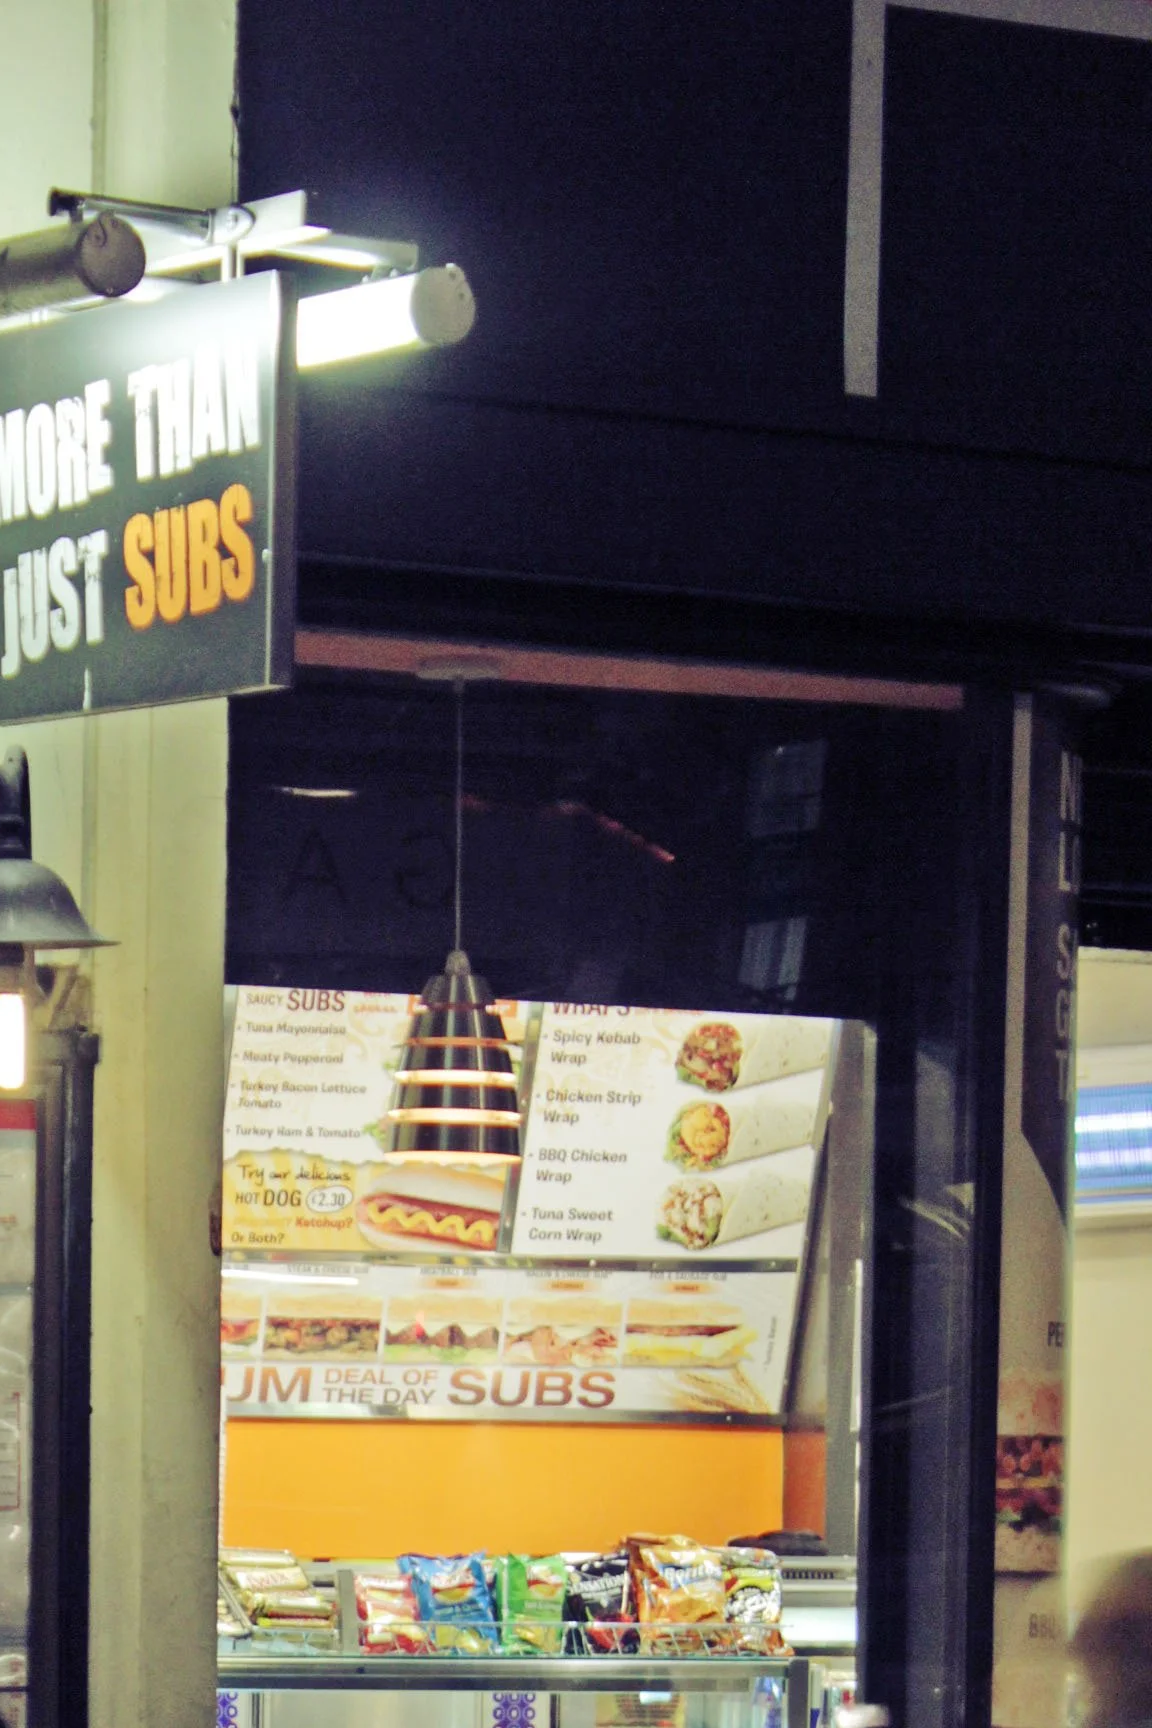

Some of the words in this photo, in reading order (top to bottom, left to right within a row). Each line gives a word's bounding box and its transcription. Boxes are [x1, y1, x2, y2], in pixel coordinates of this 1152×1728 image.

[127, 334, 261, 483] THAN
[1, 528, 109, 680] JUST
[123, 483, 255, 631] SUBS
[247, 993, 284, 1006] SAUCY
[287, 990, 346, 1012] SUBS
[246, 1022, 273, 1034] Tuna
[276, 1023, 346, 1038] Mayonnaise
[553, 1029, 592, 1046] Spicy
[596, 1031, 641, 1045] Kebab
[242, 1050, 280, 1064] Meaty
[283, 1052, 344, 1066] Pepperoni
[551, 1051, 587, 1066] Wrap
[240, 1080, 279, 1094] Turkey
[282, 1081, 318, 1093] Bacon
[321, 1082, 367, 1095] Lettuce
[238, 1096, 282, 1110] Tomato
[546, 1089, 601, 1104] Chicken
[606, 1091, 642, 1107] Strip
[543, 1110, 580, 1125] Wrap
[234, 1124, 274, 1139] Turkey
[277, 1125, 303, 1138] Ham
[305, 1125, 314, 1137] &
[317, 1126, 362, 1139] Tomato
[538, 1148, 567, 1163] BBQ
[570, 1149, 627, 1163] Chicken
[239, 1164, 264, 1186] Try
[535, 1169, 572, 1184] Wrap
[235, 1192, 259, 1204] HOT
[263, 1189, 302, 1207] DOG
[531, 1207, 564, 1221] Tuna
[567, 1207, 614, 1221] Sweet
[295, 1217, 354, 1231] Ketchup?
[248, 1233, 285, 1244] Both?
[528, 1227, 562, 1241] Corn
[565, 1228, 603, 1245] Wrap
[324, 1367, 393, 1385] DEAL
[402, 1368, 439, 1386] OF
[322, 1387, 374, 1404] THE
[382, 1388, 437, 1405] DAY
[447, 1368, 617, 1408] SUBS
